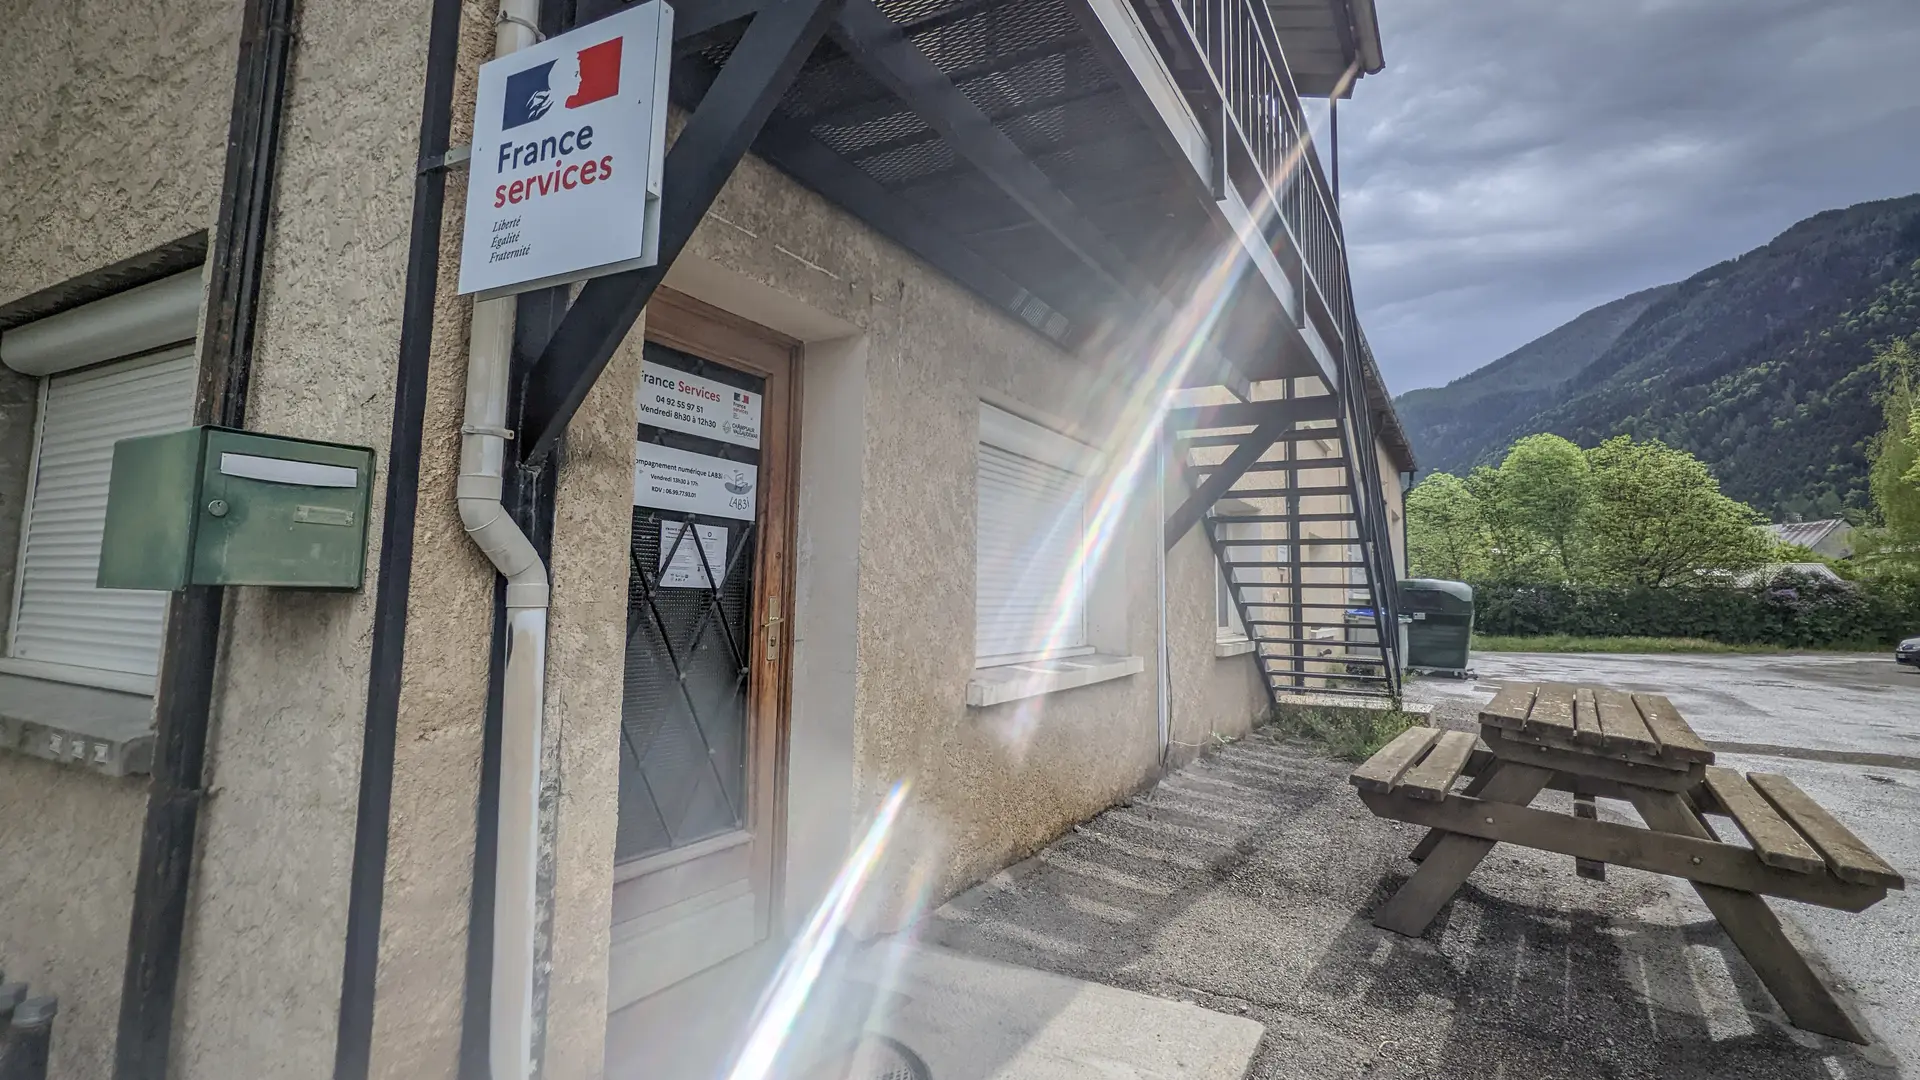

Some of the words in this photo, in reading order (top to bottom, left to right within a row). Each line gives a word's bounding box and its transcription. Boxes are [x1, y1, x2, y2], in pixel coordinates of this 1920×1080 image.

[498, 125, 594, 174] France
[494, 155, 614, 209] services
[492, 215, 522, 232] Liberté
[490, 231, 521, 249] Égalité
[489, 244, 531, 263] Fraternité
[678, 380, 721, 403] Services
[655, 395, 665, 404] 04
[666, 397, 676, 407] 92
[677, 400, 686, 409] 55
[686, 402, 695, 411] 97
[696, 405, 704, 414] 51
[640, 403, 673, 418] Vendredi
[673, 411, 691, 422] 8h30
[691, 416, 697, 424] à
[697, 417, 717, 429] 12h30
[650, 473, 672, 482] Vendredi
[677, 466, 707, 477] numérique
[651, 485, 663, 493] RDV
